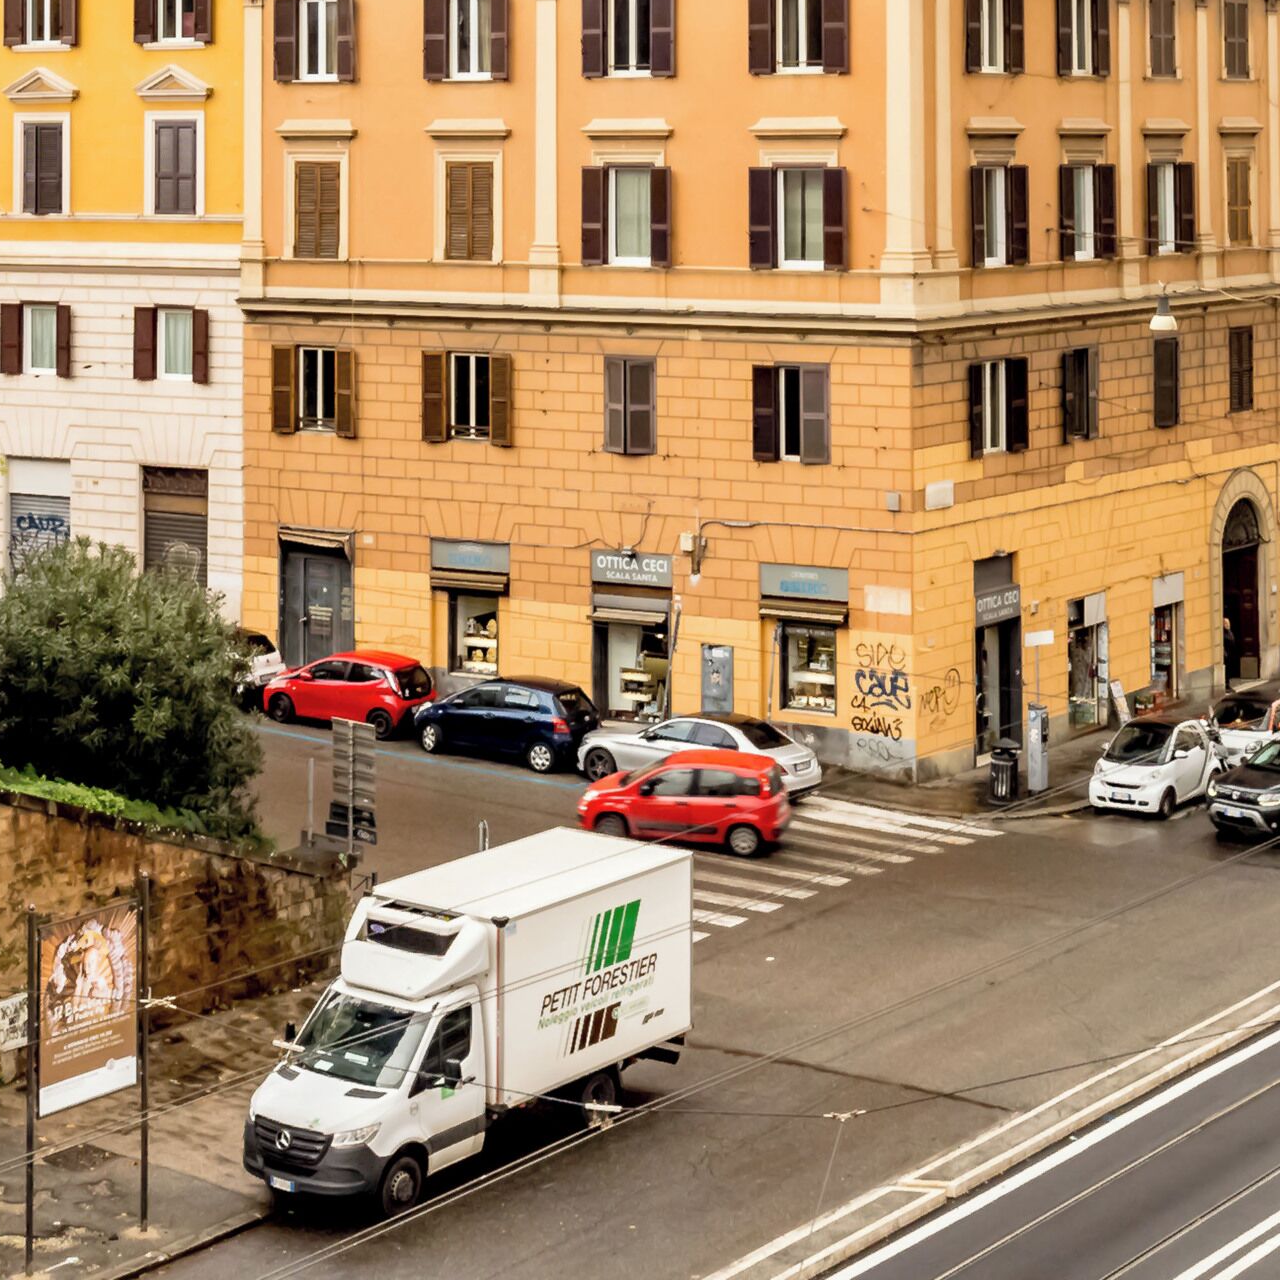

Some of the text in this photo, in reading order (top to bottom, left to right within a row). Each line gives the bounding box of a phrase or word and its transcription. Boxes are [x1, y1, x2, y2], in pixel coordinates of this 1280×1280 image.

[596, 555, 668, 572] OTTICA CECI
[606, 570, 658, 583] SCALA SANTA
[976, 590, 1019, 613] OTTICA CECI
[540, 952, 658, 1017] PETIT FORESTIER
[537, 1006, 579, 1031] Noleggio
[581, 992, 610, 1013] veicoli
[611, 975, 655, 1002] refrigerati
